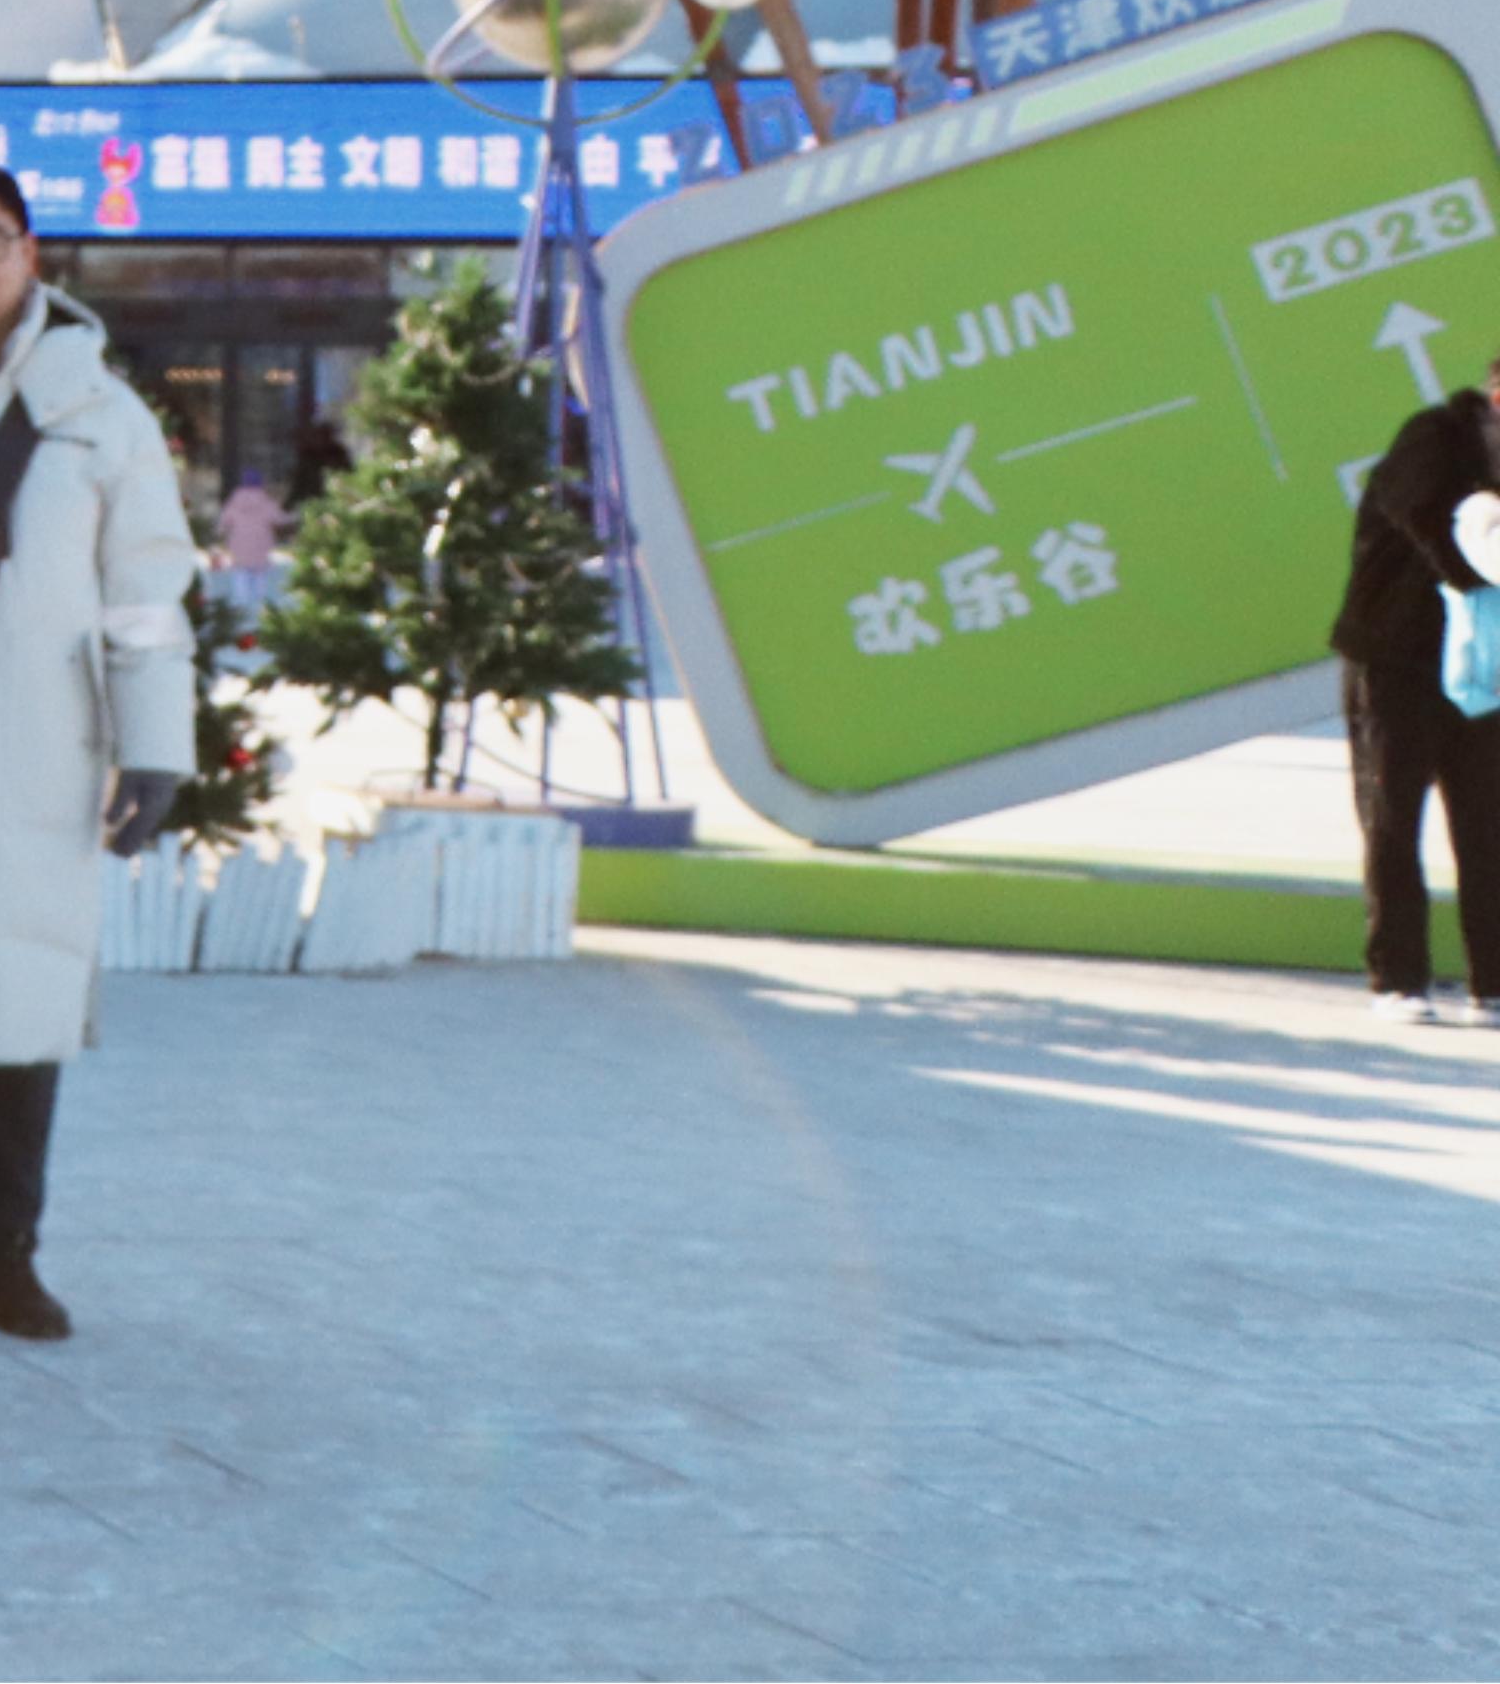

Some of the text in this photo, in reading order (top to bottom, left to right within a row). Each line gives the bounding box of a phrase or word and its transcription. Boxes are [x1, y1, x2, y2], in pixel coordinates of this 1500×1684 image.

[1270, 192, 1478, 290] 2023
[725, 282, 1077, 434] TIANJIN
[846, 520, 1119, 656] 欢乐谷
